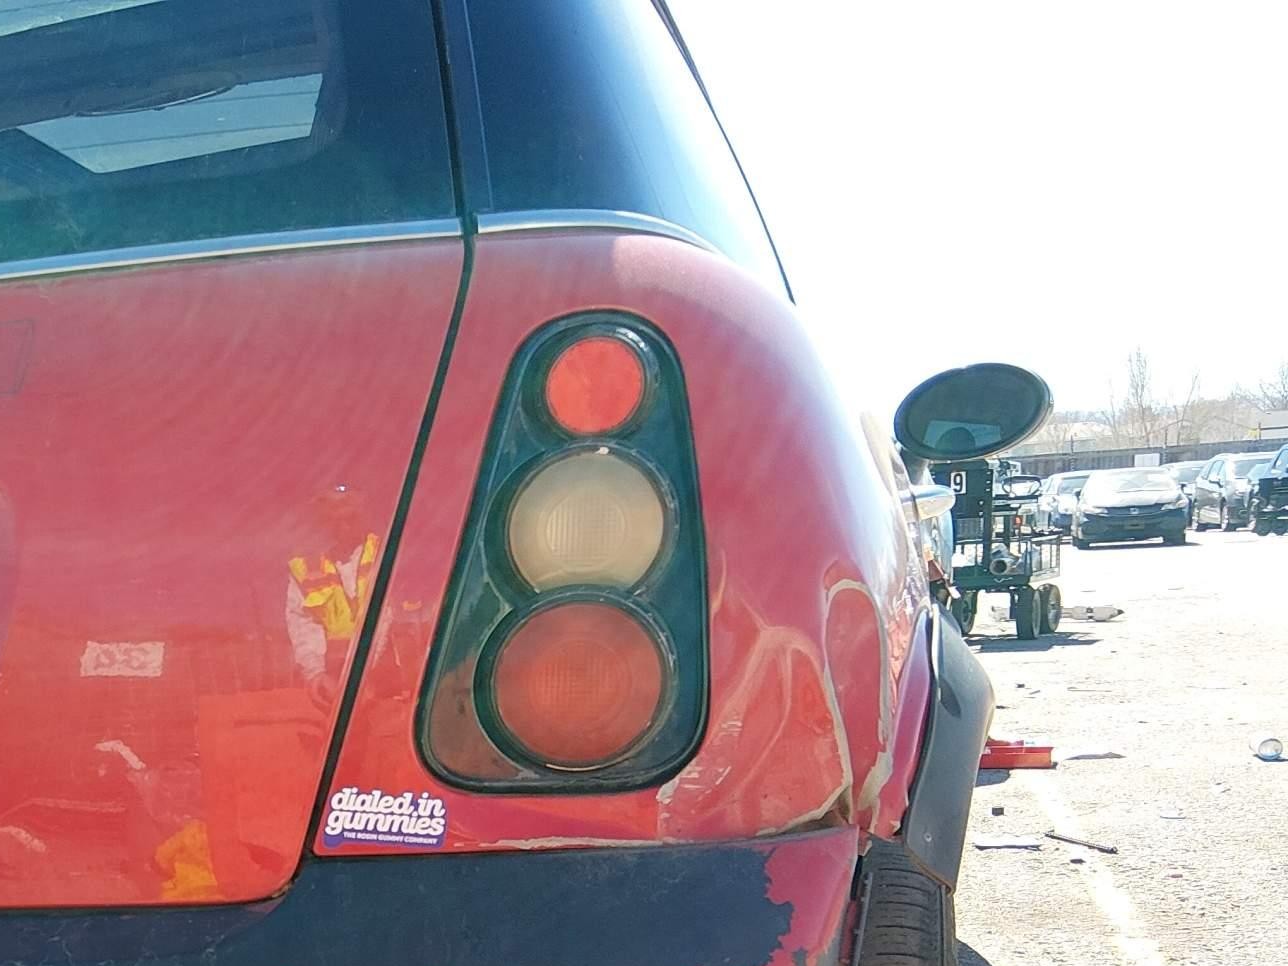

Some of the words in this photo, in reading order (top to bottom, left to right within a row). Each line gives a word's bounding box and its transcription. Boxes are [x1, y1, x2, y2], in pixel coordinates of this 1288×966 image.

[952, 472, 964, 493] 9
[331, 787, 415, 815] dialed
[417, 792, 446, 817] in
[325, 811, 445, 835] gummies
